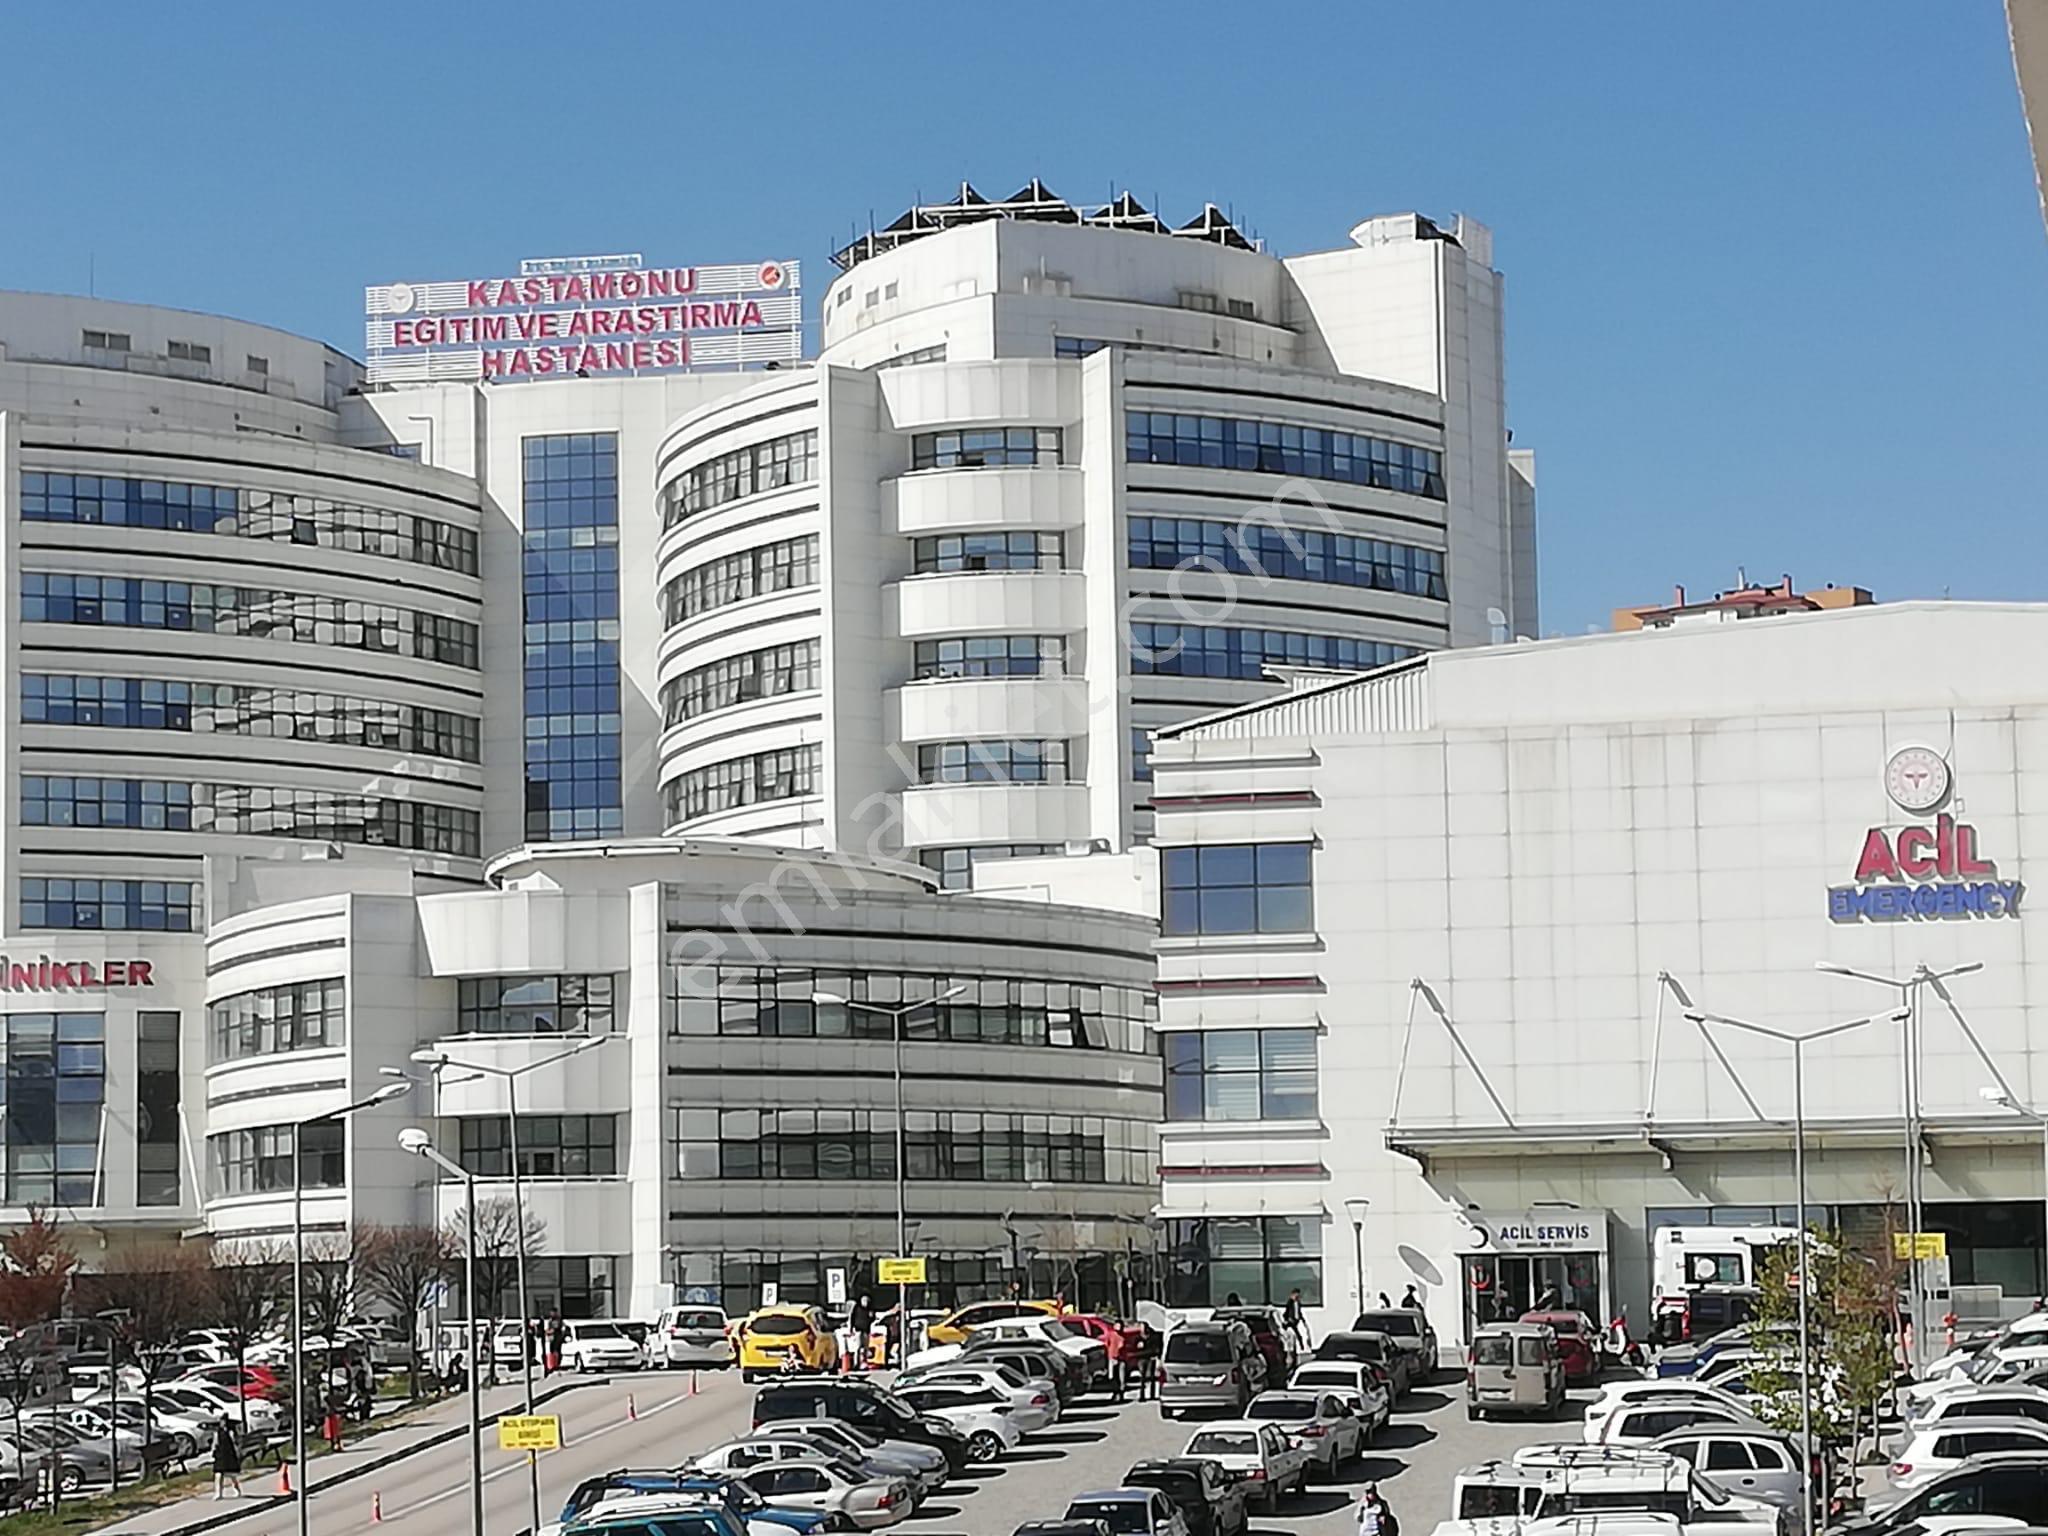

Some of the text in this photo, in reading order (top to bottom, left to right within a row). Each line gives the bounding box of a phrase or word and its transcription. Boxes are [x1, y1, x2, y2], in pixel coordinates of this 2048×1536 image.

[467, 268, 697, 308] KASTAMONU
[515, 313, 558, 339] VE
[1855, 813, 1997, 881] ACİL
[1828, 881, 2026, 922] EMERGENCY
[1500, 1222, 1589, 1240] ACİL SERVİS
[831, 1272, 841, 1288] P
[766, 1287, 773, 1301] P
